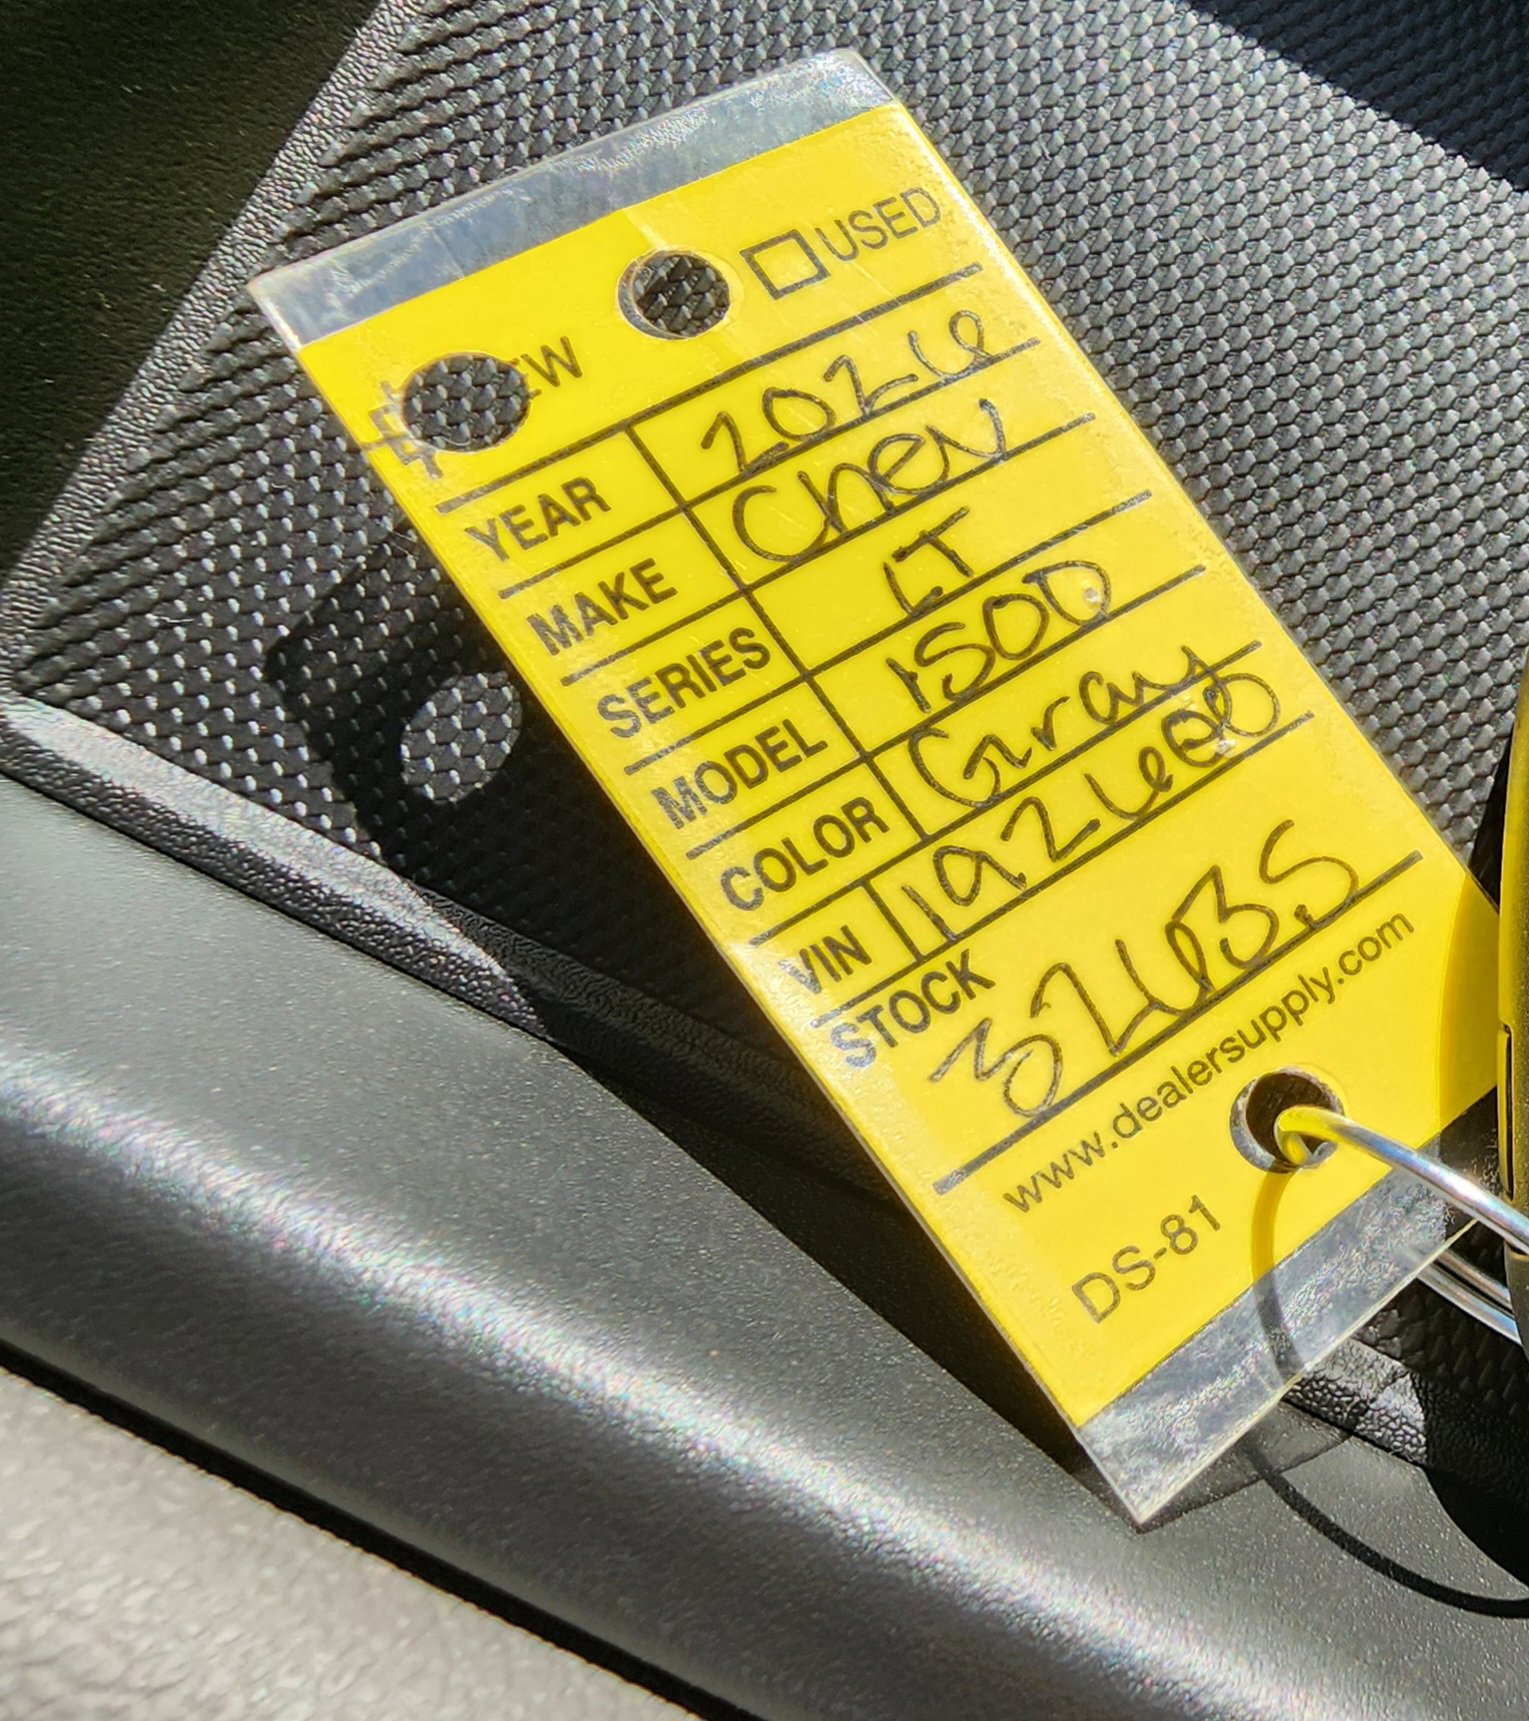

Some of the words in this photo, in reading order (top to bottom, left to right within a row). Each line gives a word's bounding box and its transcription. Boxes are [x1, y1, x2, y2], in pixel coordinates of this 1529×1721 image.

[815, 186, 942, 264] USED
[700, 309, 993, 473] 2026
[465, 475, 612, 561] YEAR
[731, 397, 1008, 563] Chev
[526, 558, 679, 656] MAKE
[882, 505, 974, 616] LT
[598, 626, 772, 739] SERIES
[885, 559, 1111, 713] 1500
[650, 718, 829, 831] MODEL
[907, 644, 1233, 809] Gray
[720, 796, 890, 909] COLOR
[779, 924, 872, 996] VIN
[829, 948, 996, 1069] STOCK
[1000, 911, 1415, 1215] www.dealersupply.com
[1071, 1193, 1223, 1325] DS-81
